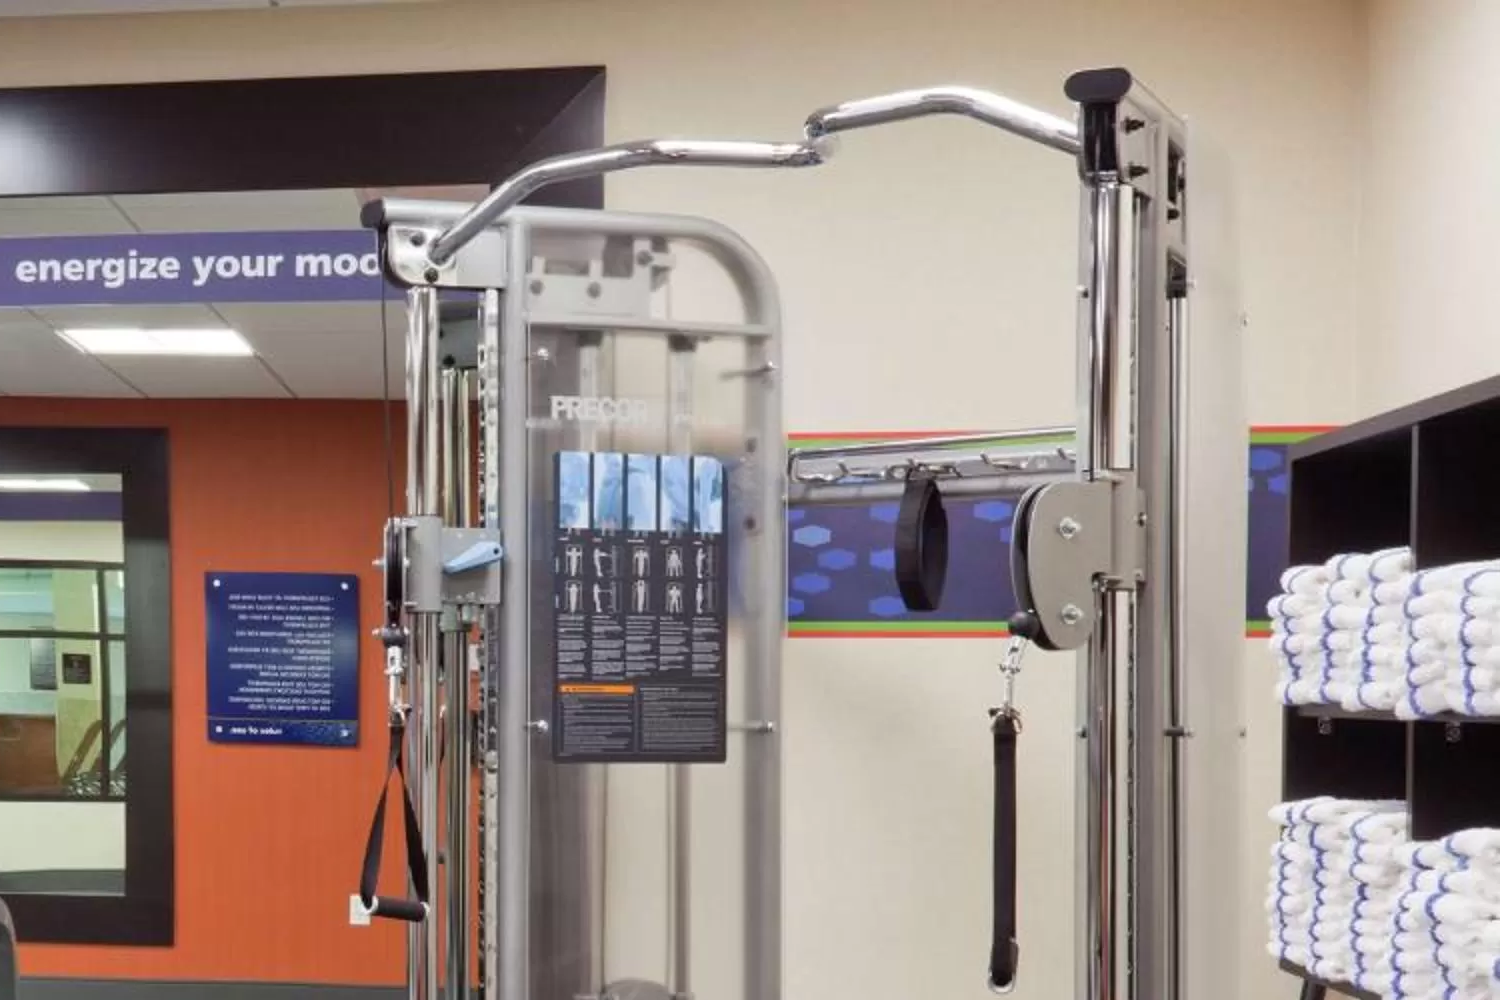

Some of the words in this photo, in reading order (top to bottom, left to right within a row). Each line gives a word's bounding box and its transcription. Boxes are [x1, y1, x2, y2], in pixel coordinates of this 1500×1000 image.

[15, 250, 181, 288] energize
[192, 253, 283, 285] your
[295, 253, 381, 277] moo
